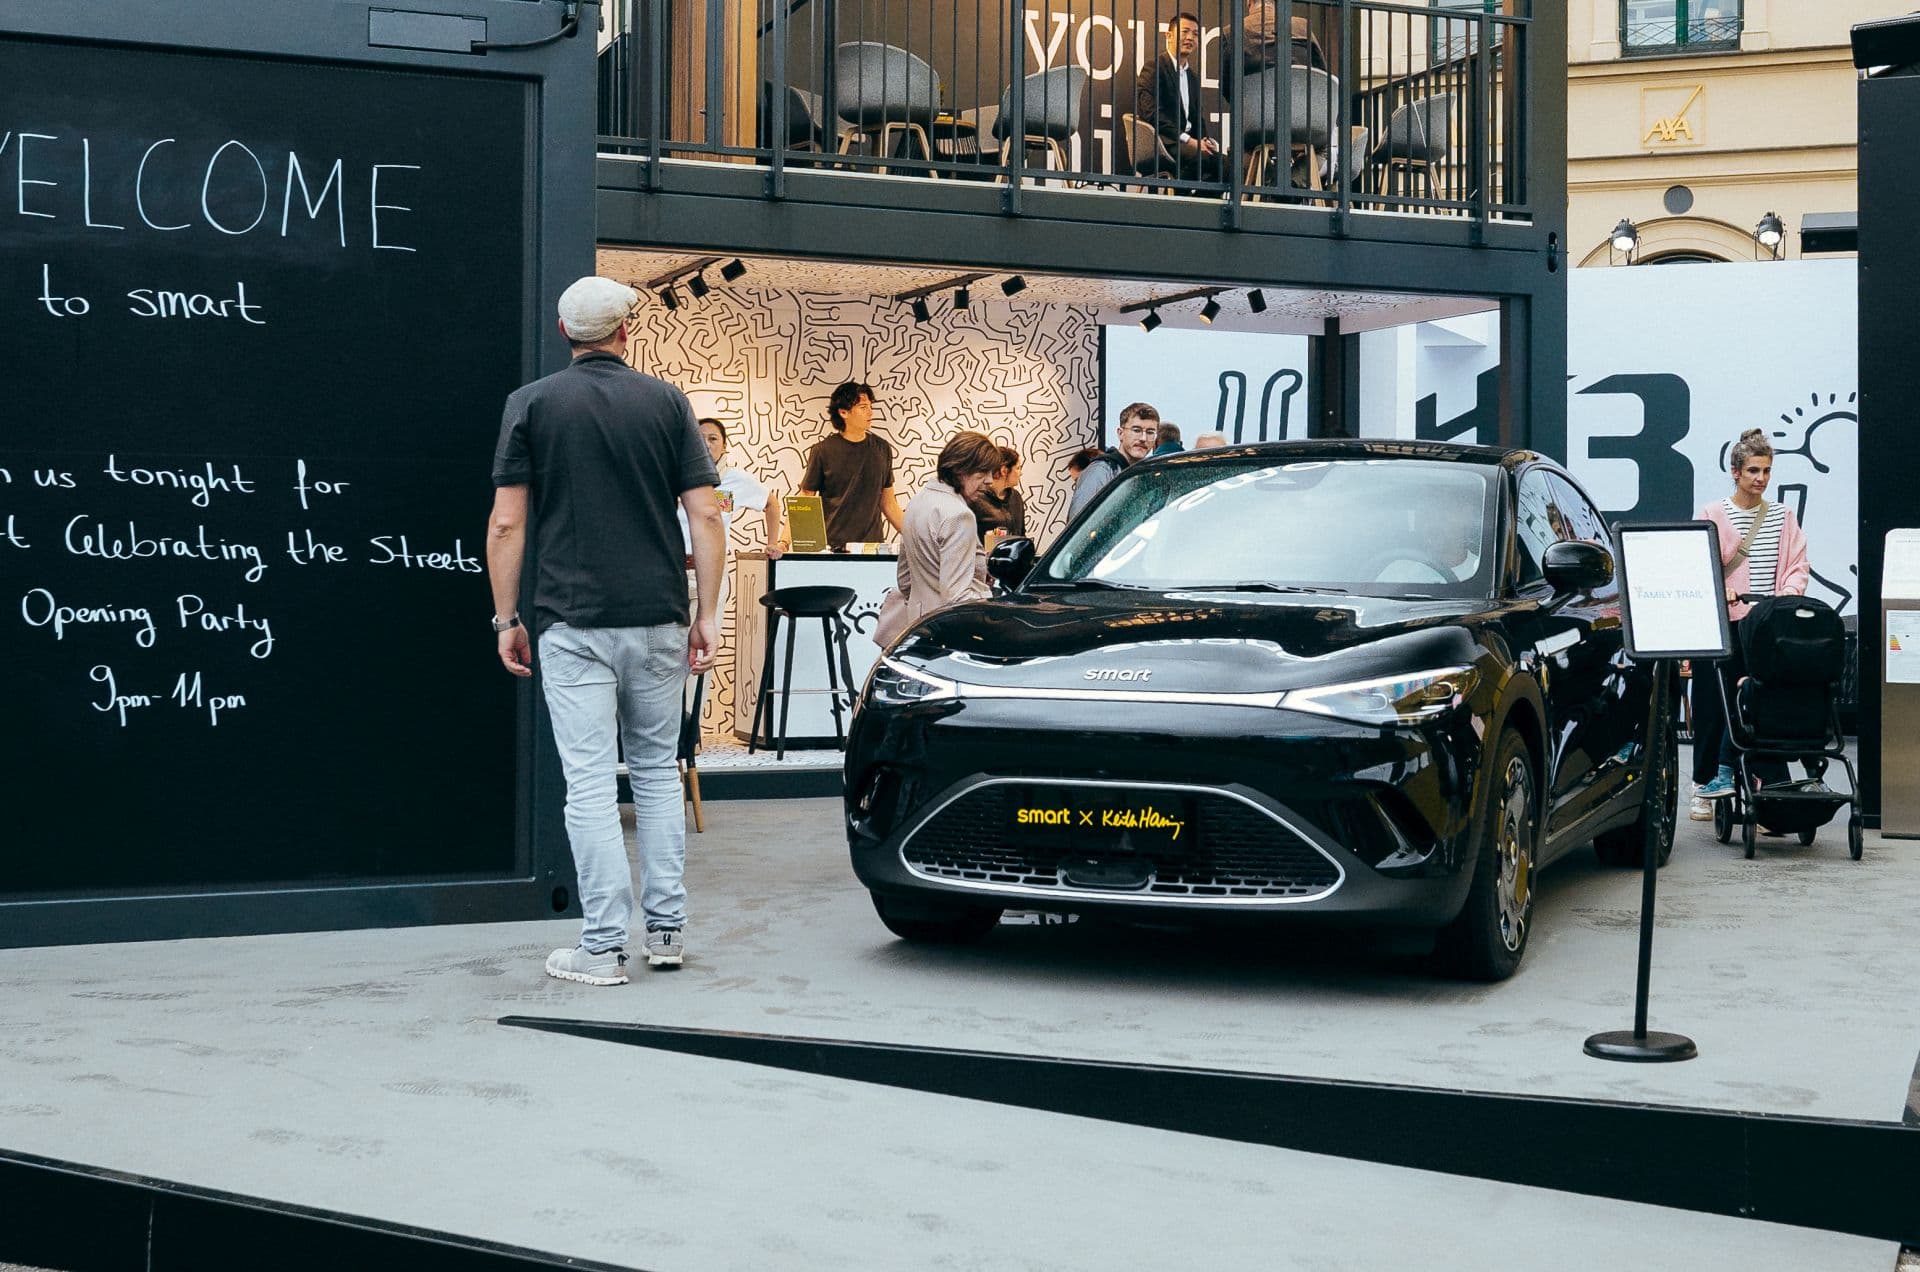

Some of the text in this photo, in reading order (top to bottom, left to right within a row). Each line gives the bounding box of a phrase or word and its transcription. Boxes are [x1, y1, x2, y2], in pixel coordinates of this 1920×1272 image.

[1644, 116, 1692, 141] AXA
[38, 264, 265, 324] to smart
[35, 469, 76, 488] us
[104, 455, 255, 507] tonight
[293, 459, 350, 509] for
[65, 515, 268, 582] Celebrating
[287, 529, 347, 564] the
[370, 536, 483, 572] Streets
[1637, 589, 1703, 599] FAMILY TRAIL
[23, 589, 275, 658] Opening Party
[1083, 668, 1152, 682] smart
[1017, 808, 1070, 824] smart
